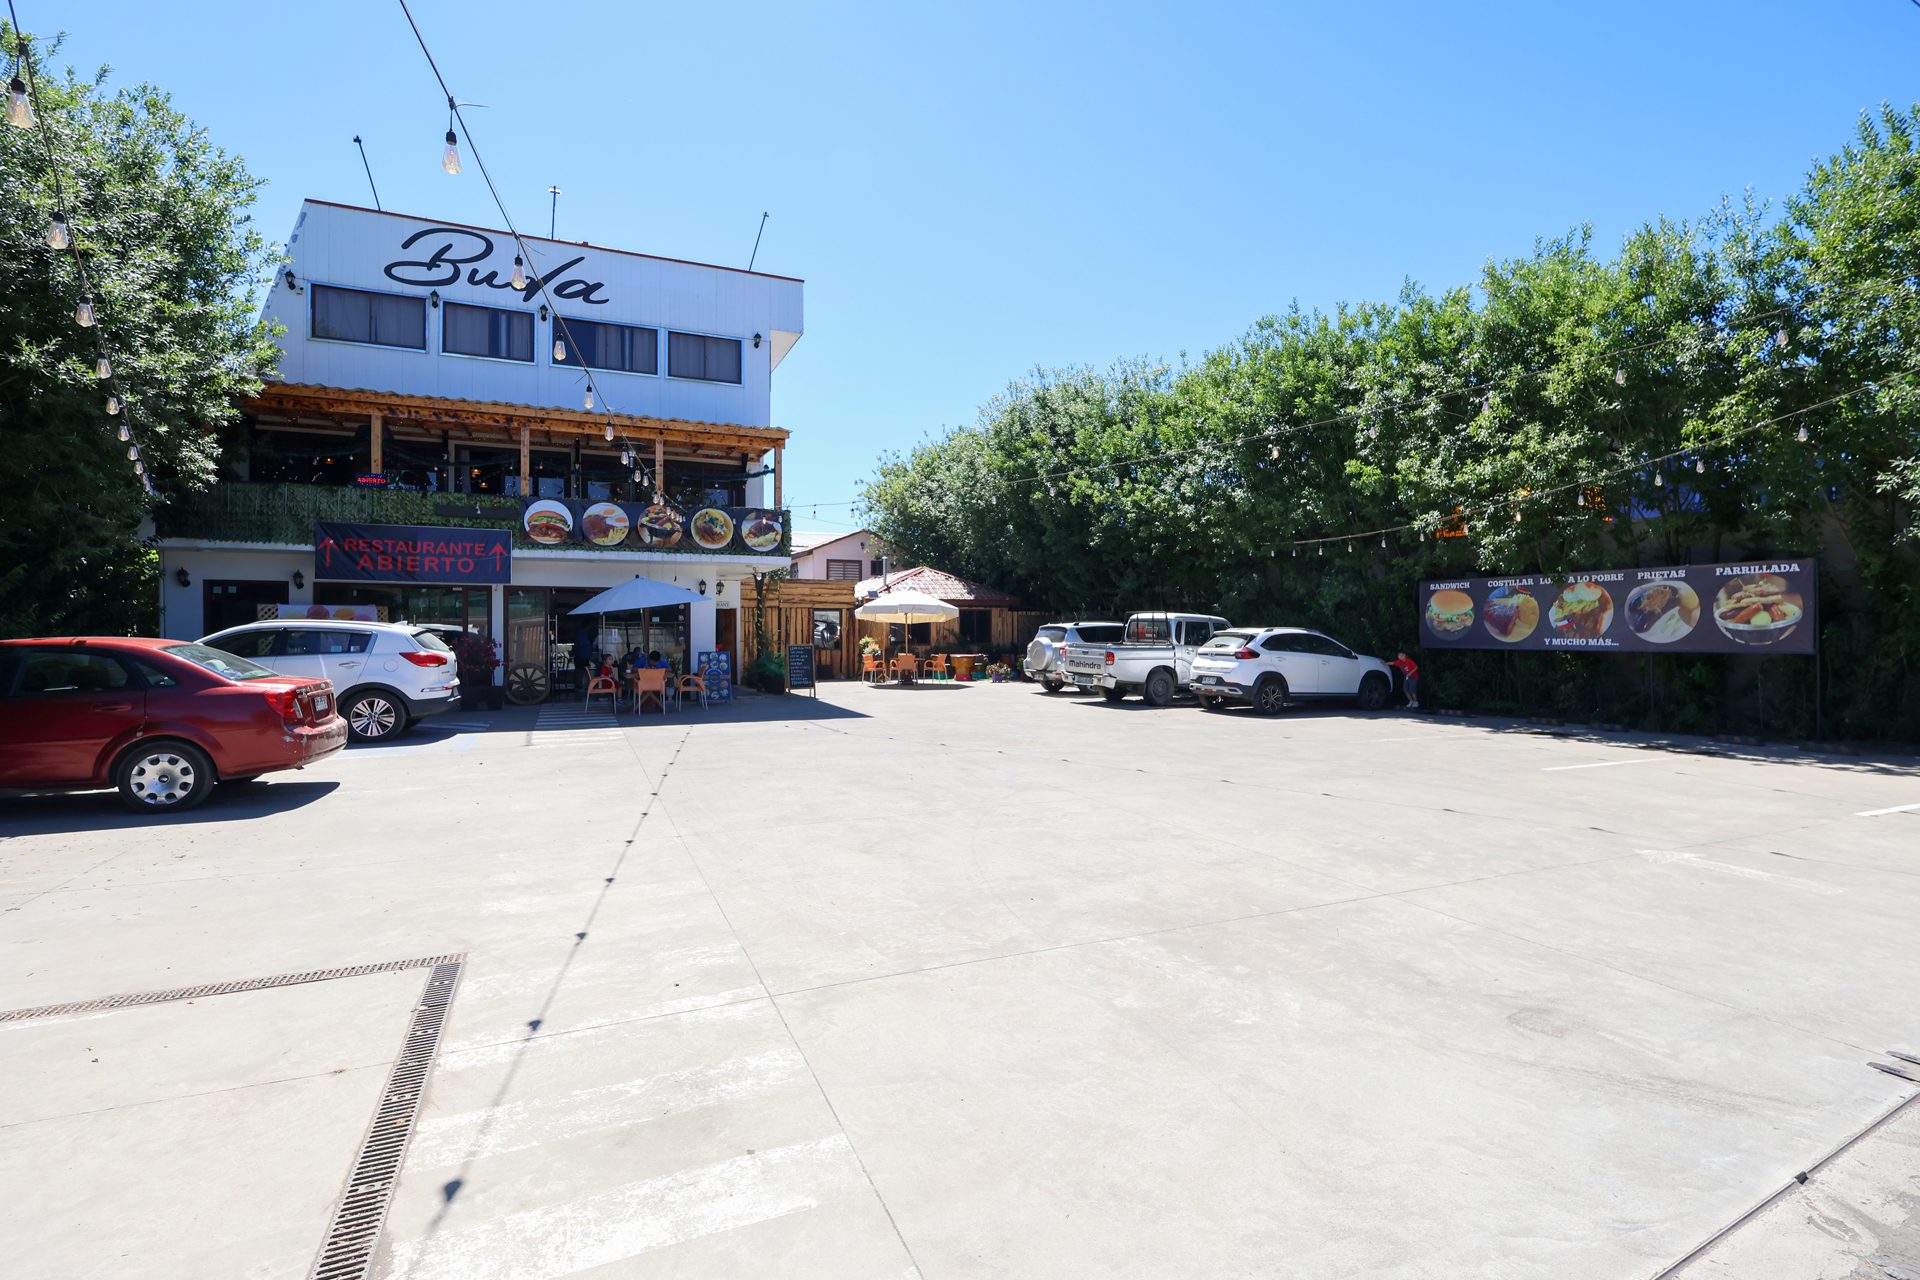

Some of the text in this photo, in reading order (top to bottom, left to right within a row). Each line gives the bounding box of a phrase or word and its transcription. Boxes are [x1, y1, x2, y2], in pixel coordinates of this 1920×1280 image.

[343, 537, 487, 557] RESTAURANTE
[355, 554, 475, 574] ABIERTO
[1637, 569, 1686, 580] PRIETAS
[1715, 563, 1801, 577] PARRILLADA
[1487, 578, 1534, 588] COSTILLAR
[1567, 576, 1576, 584] A
[1577, 575, 1590, 583] LO
[1591, 573, 1624, 583] POBRE
[1430, 581, 1470, 591] SANDWICH
[1544, 638, 1551, 646] Y
[1552, 638, 1587, 646] MUCHO
